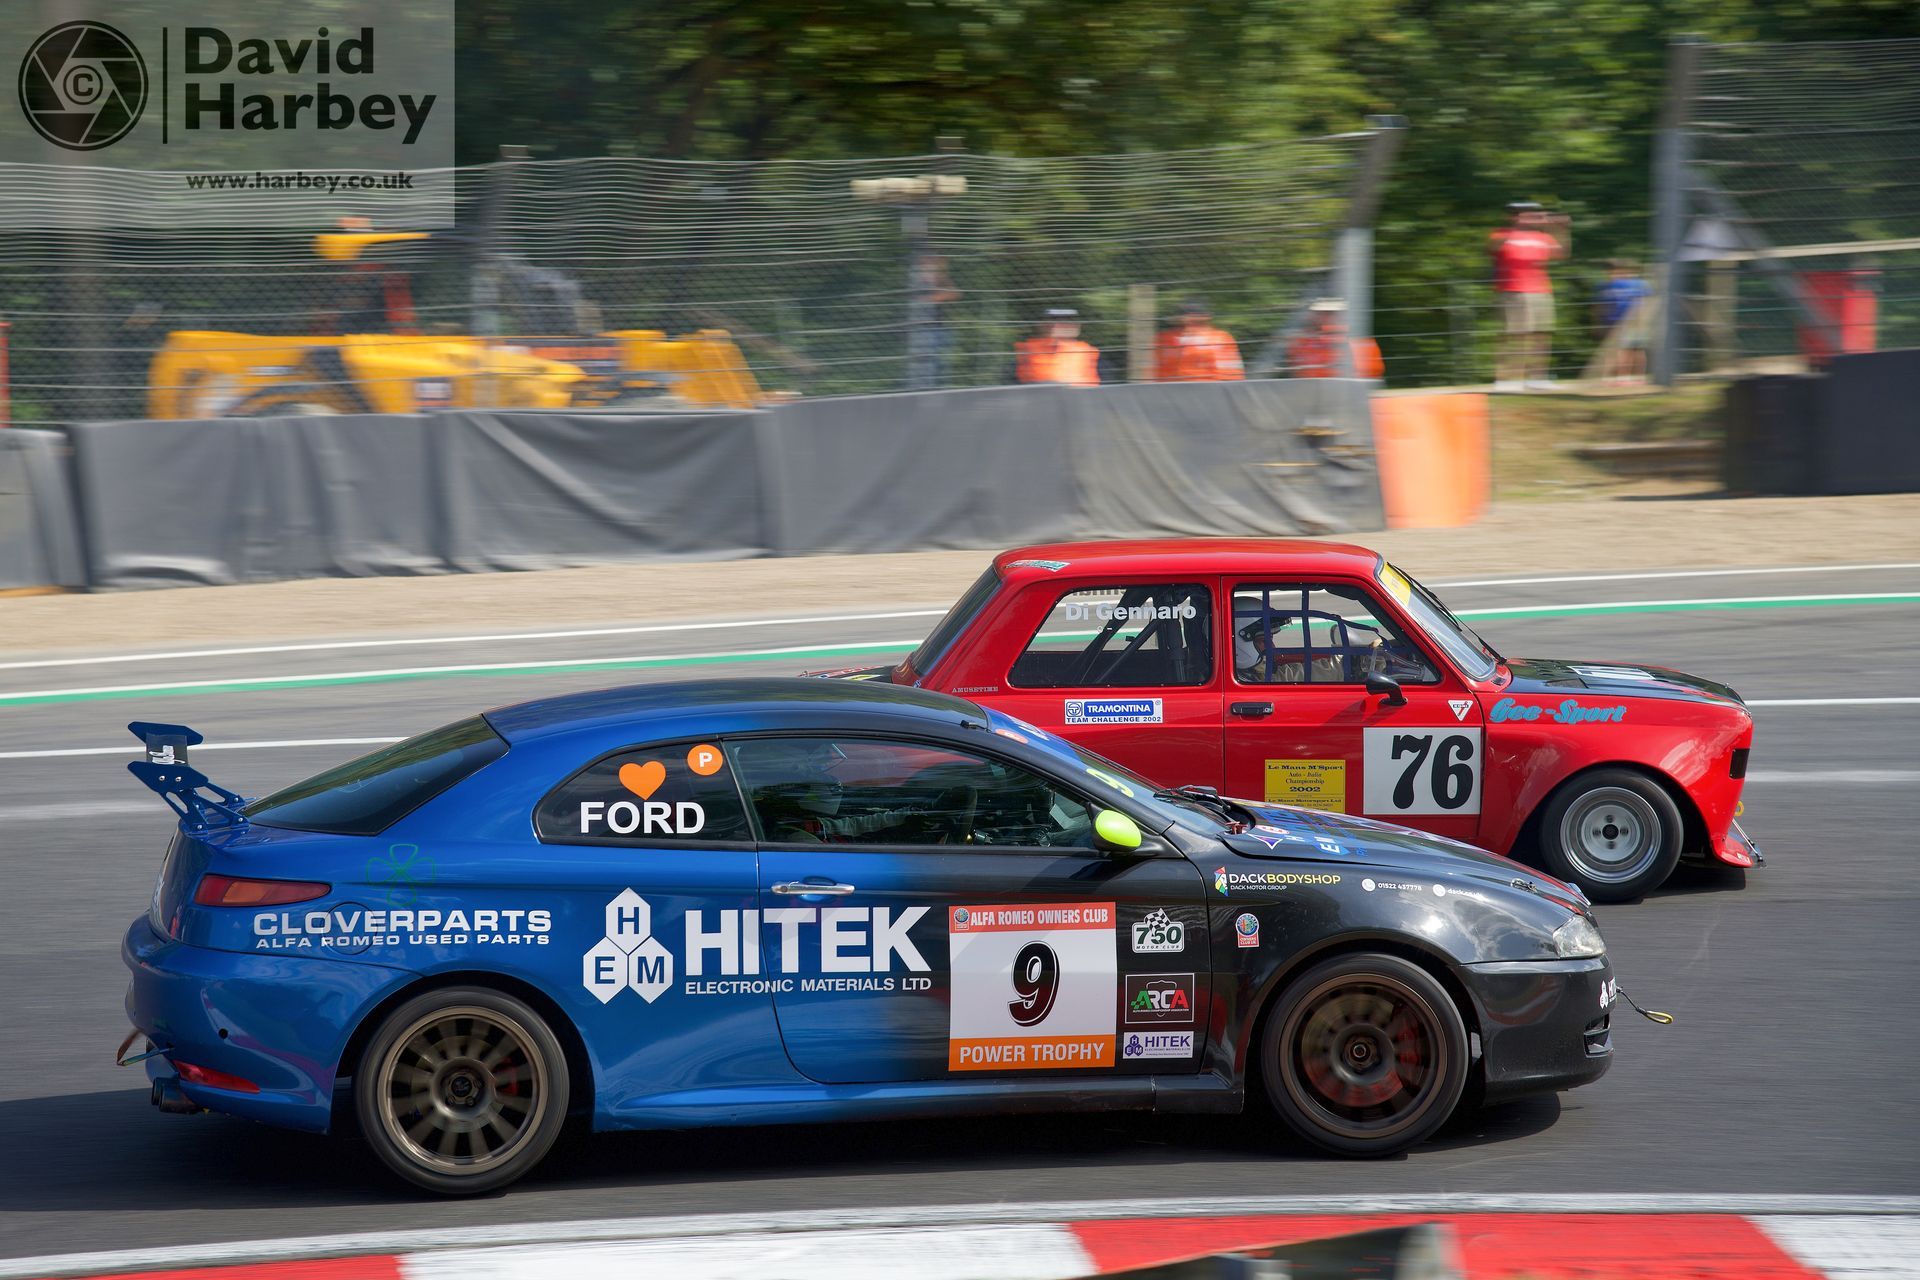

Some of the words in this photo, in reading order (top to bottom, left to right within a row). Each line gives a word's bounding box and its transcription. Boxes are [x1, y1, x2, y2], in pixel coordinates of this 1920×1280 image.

[1065, 603, 1089, 620] Di
[1096, 602, 1197, 620] Gennaro
[1087, 704, 1151, 713] TRAMONTINA
[699, 752, 713, 768] P
[1391, 734, 1474, 810] 76
[580, 801, 705, 834] FORD
[1229, 873, 1341, 885] DACKBODYSHOP
[253, 909, 552, 936] CLOVERPARTS
[618, 907, 640, 935] H
[970, 912, 995, 926] ALFA
[998, 910, 1034, 925] ROMEO
[1038, 909, 1080, 924] OWNERS
[1083, 908, 1108, 923] CLUB
[255, 938, 312, 949] ALFA
[321, 936, 400, 947] ROMEO
[409, 934, 468, 945] USED
[477, 934, 550, 945] PARTS
[685, 906, 932, 976] HITEK
[1136, 926, 1182, 944] 750
[595, 956, 615, 984] E
[637, 956, 663, 984] M
[685, 979, 793, 995] ELECTRONIC
[801, 978, 894, 992] MATERIALS
[902, 977, 931, 991] LTD
[1008, 940, 1060, 1027] 9
[1131, 990, 1189, 1009] ARCA
[1145, 1035, 1191, 1048] HITEK
[960, 1045, 1025, 1063] POWER
[1031, 1043, 1104, 1060] TROPHY
